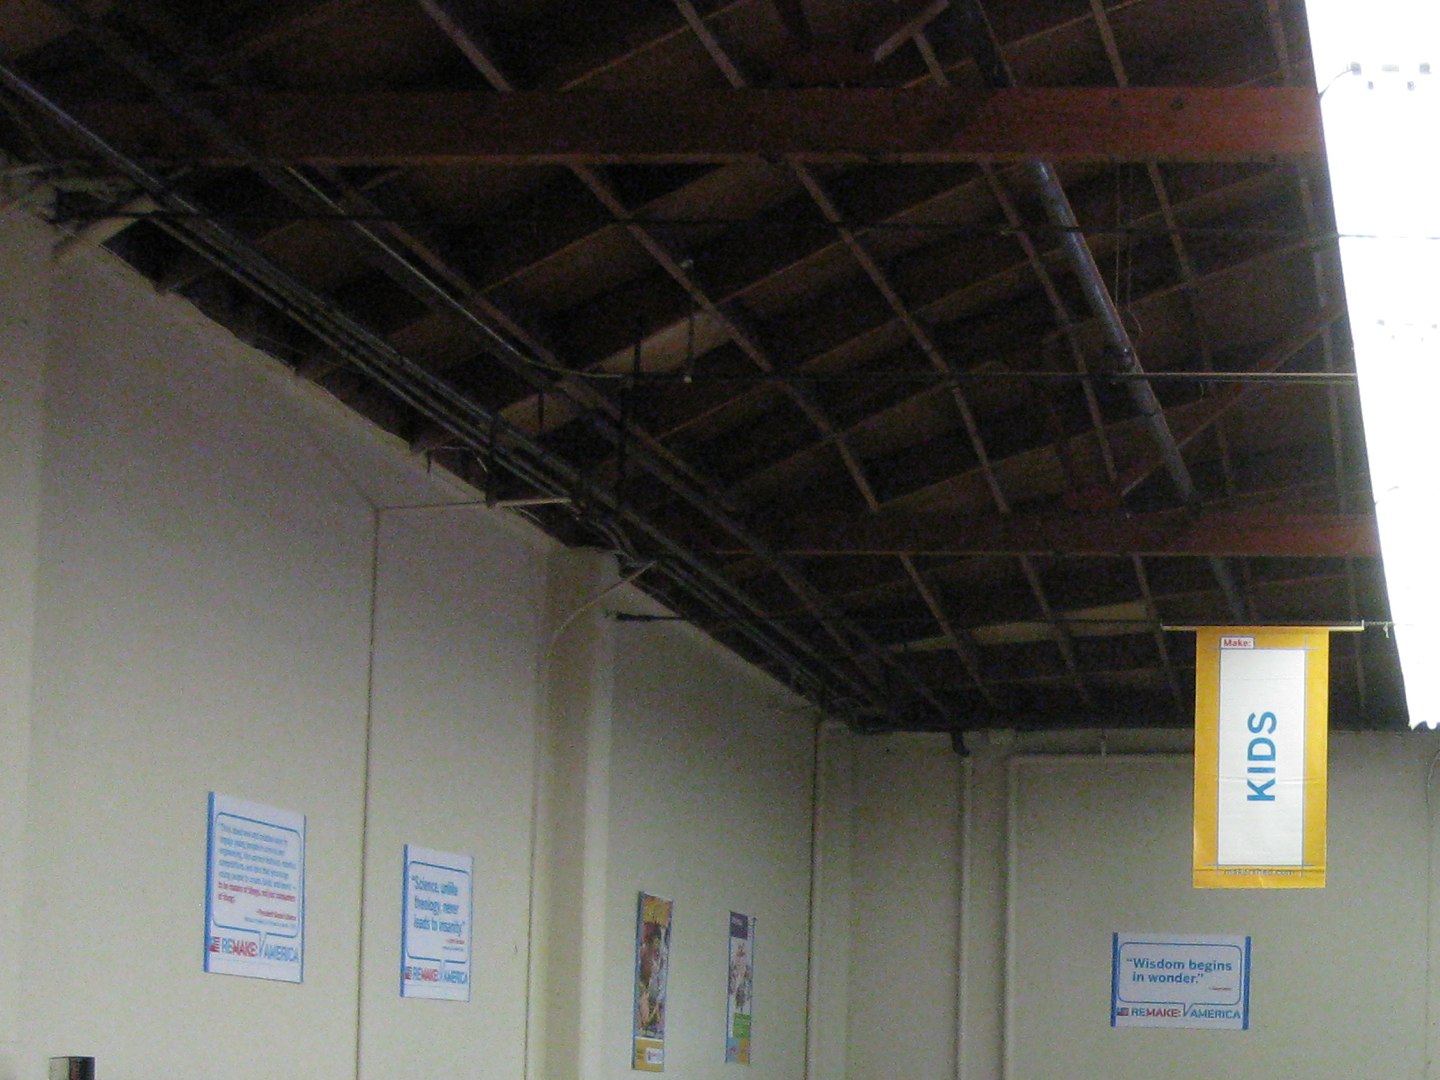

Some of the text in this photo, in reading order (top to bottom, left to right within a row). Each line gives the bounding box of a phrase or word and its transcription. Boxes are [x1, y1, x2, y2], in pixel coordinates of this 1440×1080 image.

[1223, 638, 1252, 648] Make:
[1247, 711, 1277, 801] KIDS
[1189, 959, 1232, 973] begins
[1132, 972, 1144, 982] in
[1190, 1008, 1241, 1019] AMERICA
